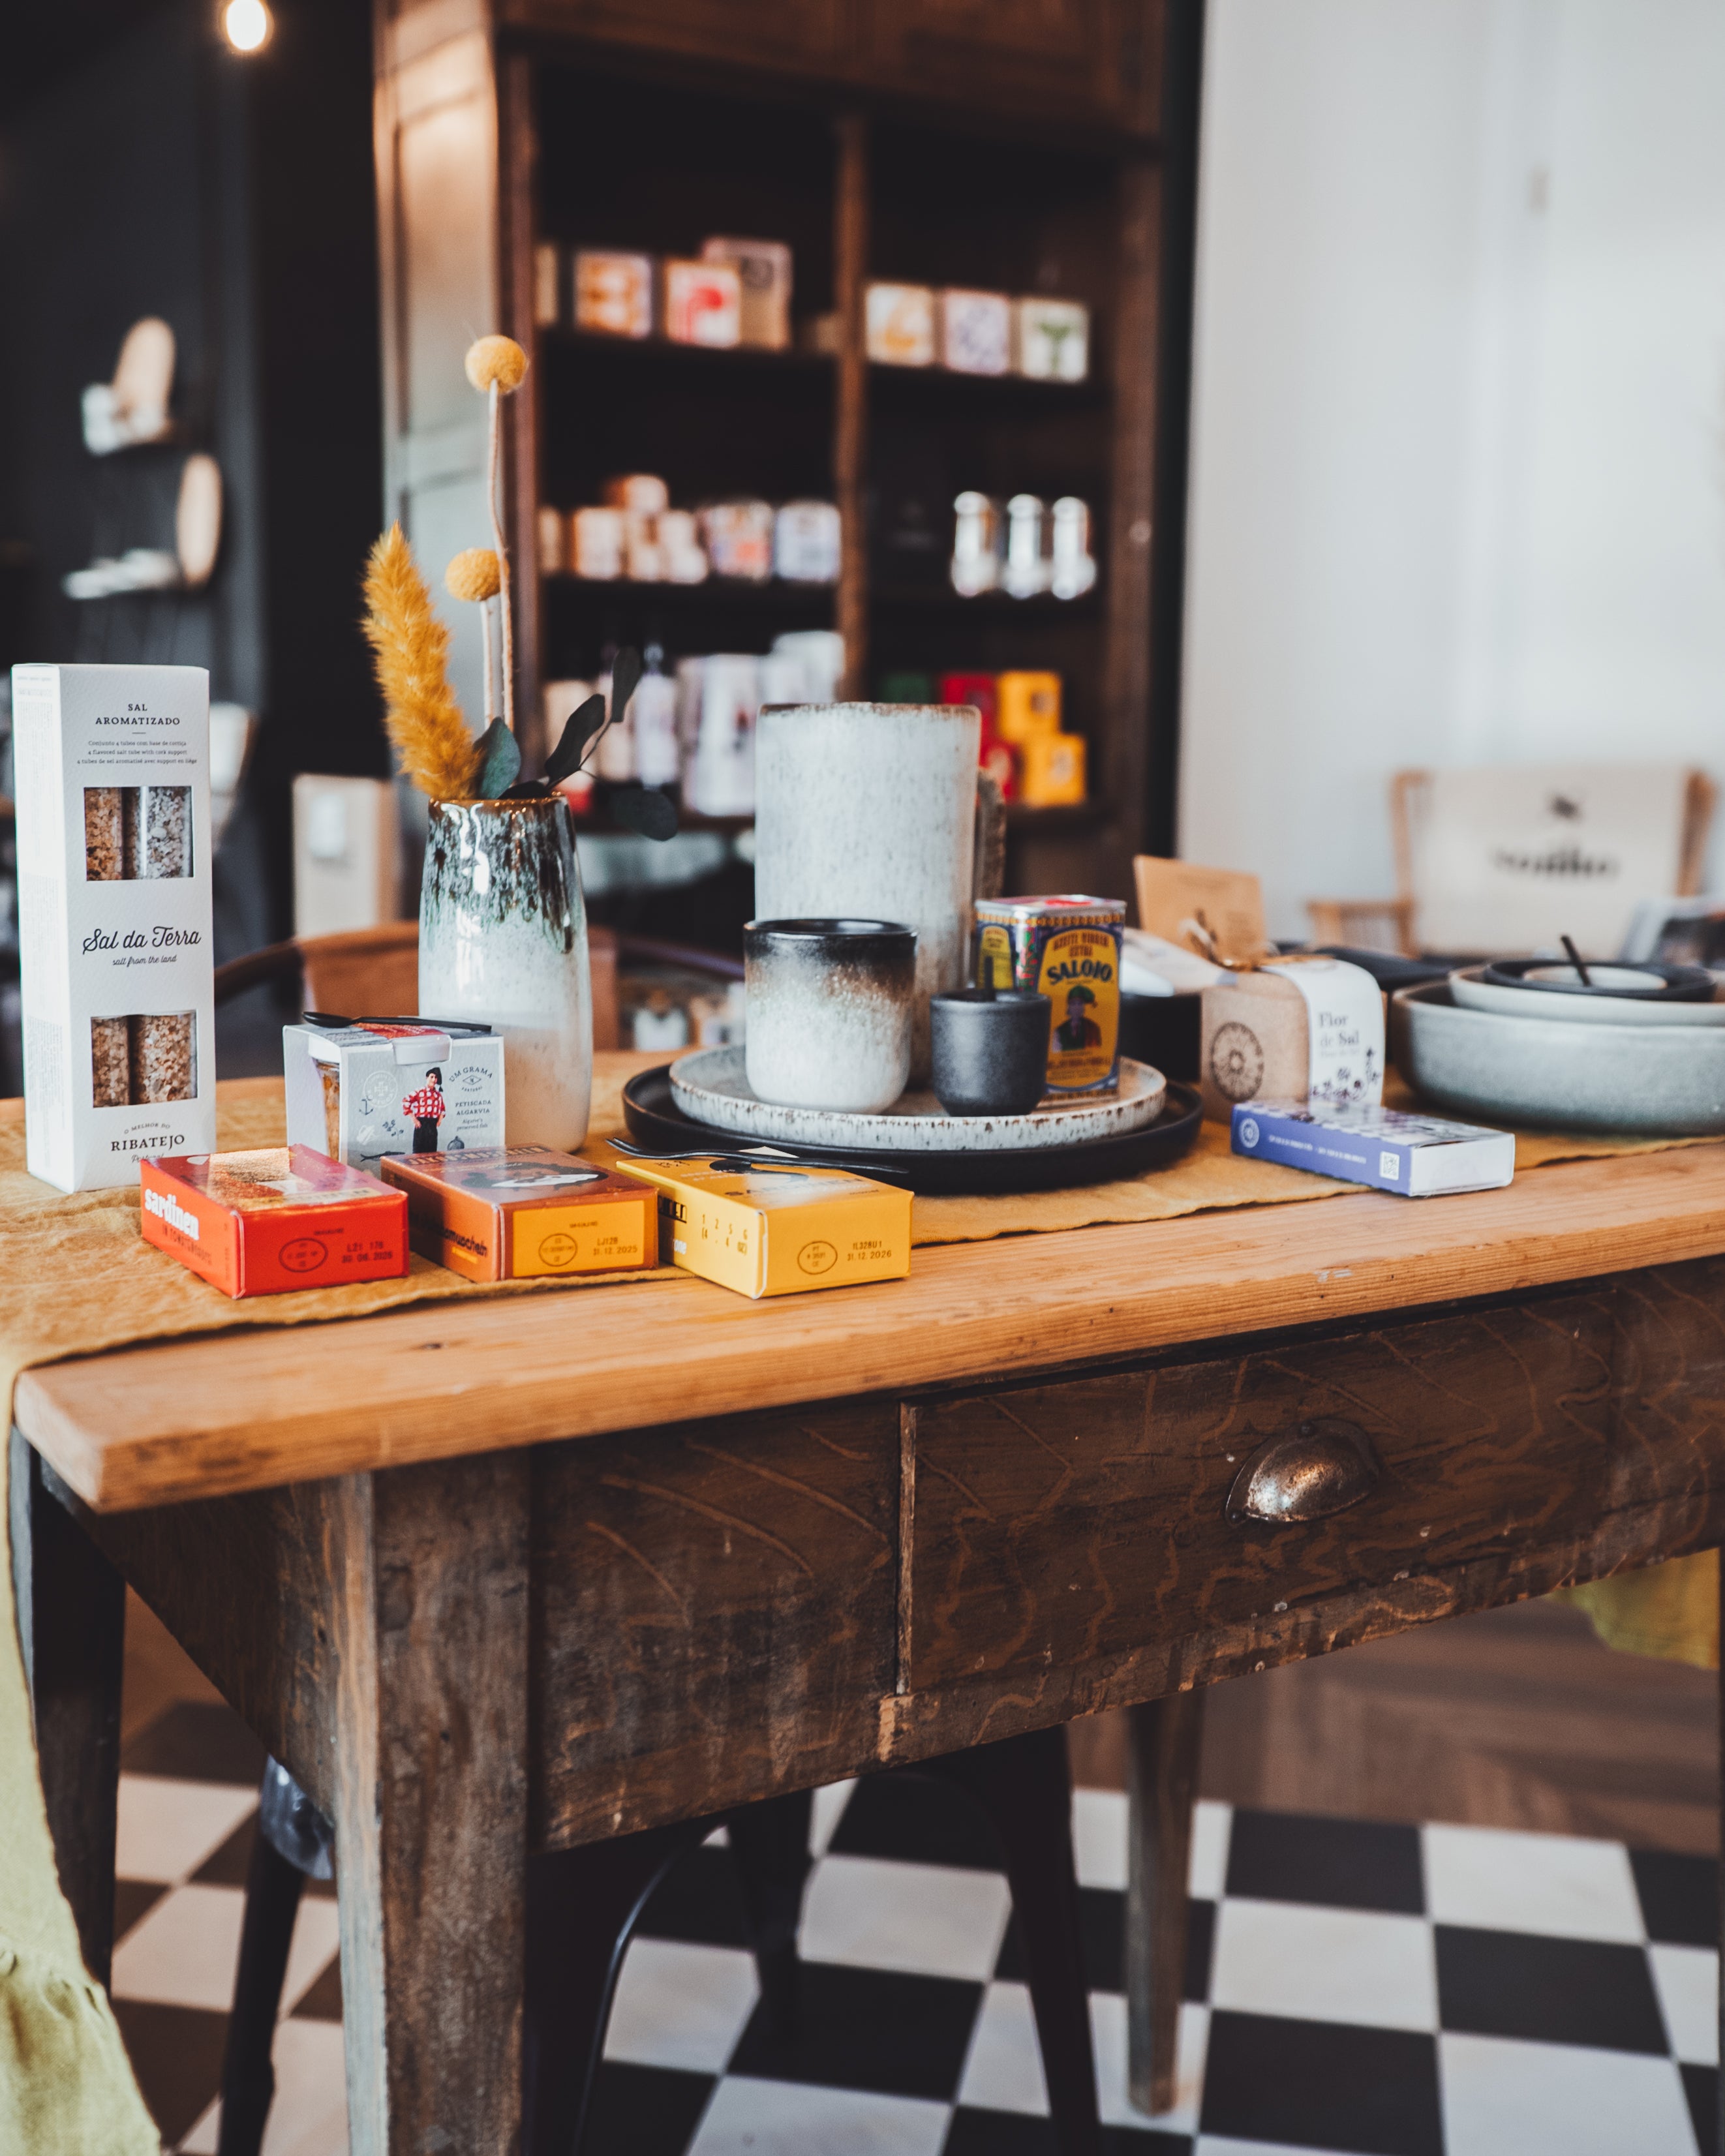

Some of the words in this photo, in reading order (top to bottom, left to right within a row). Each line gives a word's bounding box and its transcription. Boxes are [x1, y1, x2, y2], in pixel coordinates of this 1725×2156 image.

[82, 928, 119, 955] Sal
[123, 930, 147, 949] da
[152, 926, 202, 947] Terra
[127, 956, 146, 967] from
[160, 954, 177, 963] land
[1046, 959, 1113, 986] SALOIO
[1318, 1012, 1348, 1028] Flor
[463, 1066, 493, 1079] GRAMA
[131, 1123, 159, 1132] MELHOR
[111, 1134, 185, 1151] RIBATEJO
[144, 1188, 200, 1241] sardinen
